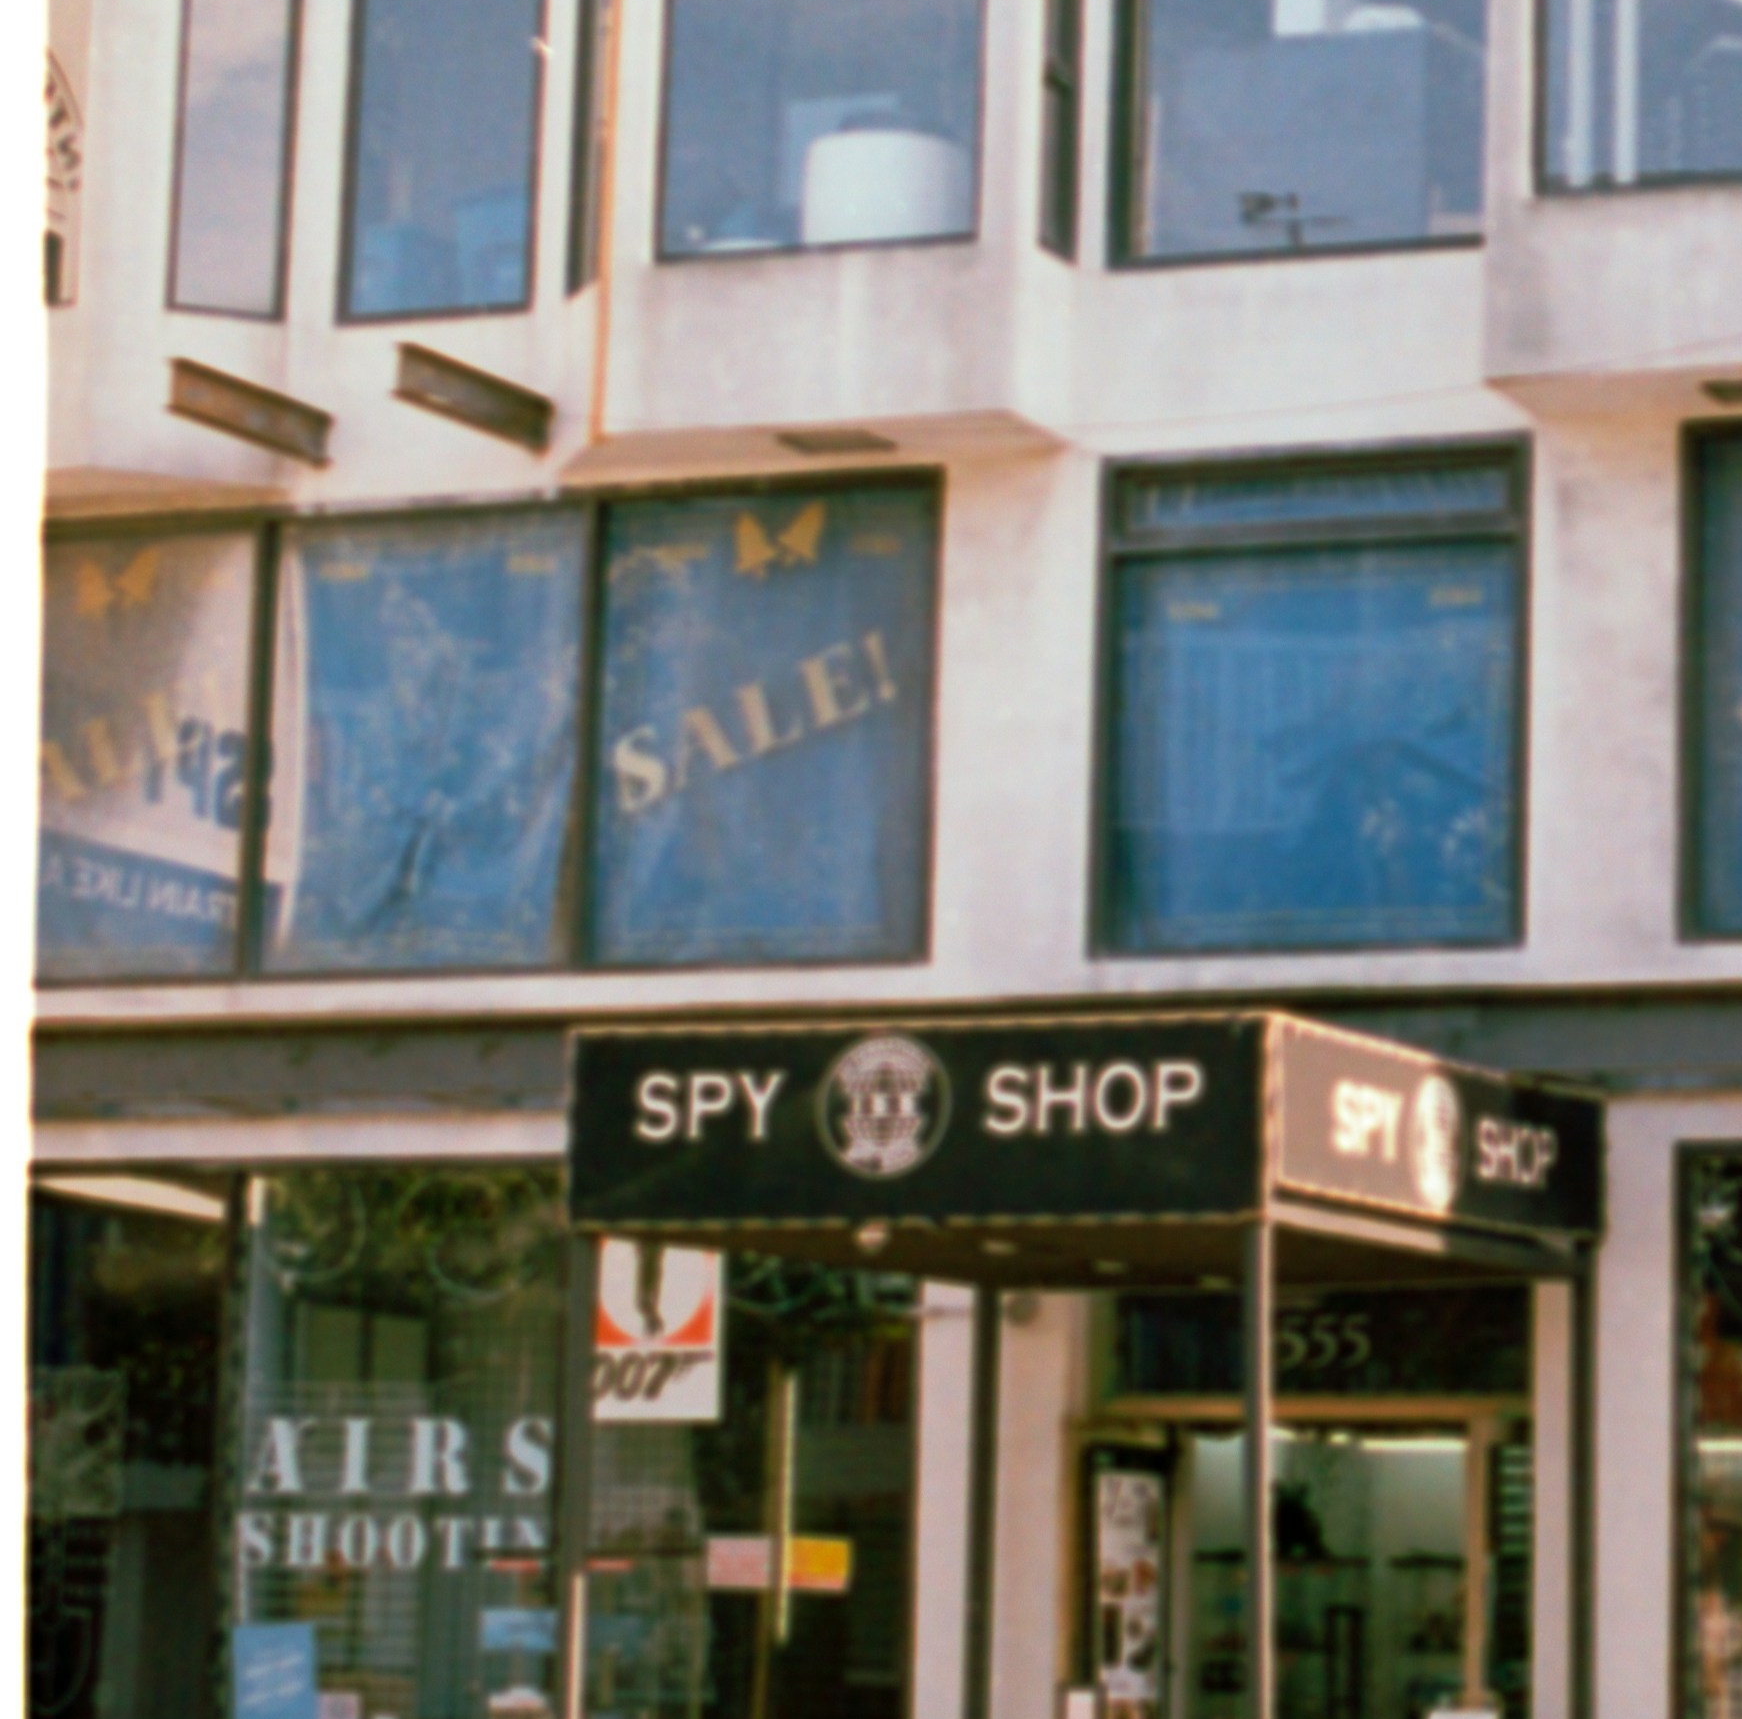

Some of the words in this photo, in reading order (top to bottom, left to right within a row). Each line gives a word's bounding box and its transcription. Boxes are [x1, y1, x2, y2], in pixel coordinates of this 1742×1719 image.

[613, 630, 899, 817] SALE!
[635, 1070, 789, 1145] SPY
[980, 1059, 1204, 1137] SHOP
[1332, 1078, 1403, 1163] SPY
[1476, 1116, 1558, 1189] SHOP
[245, 1415, 554, 1494] AIRS
